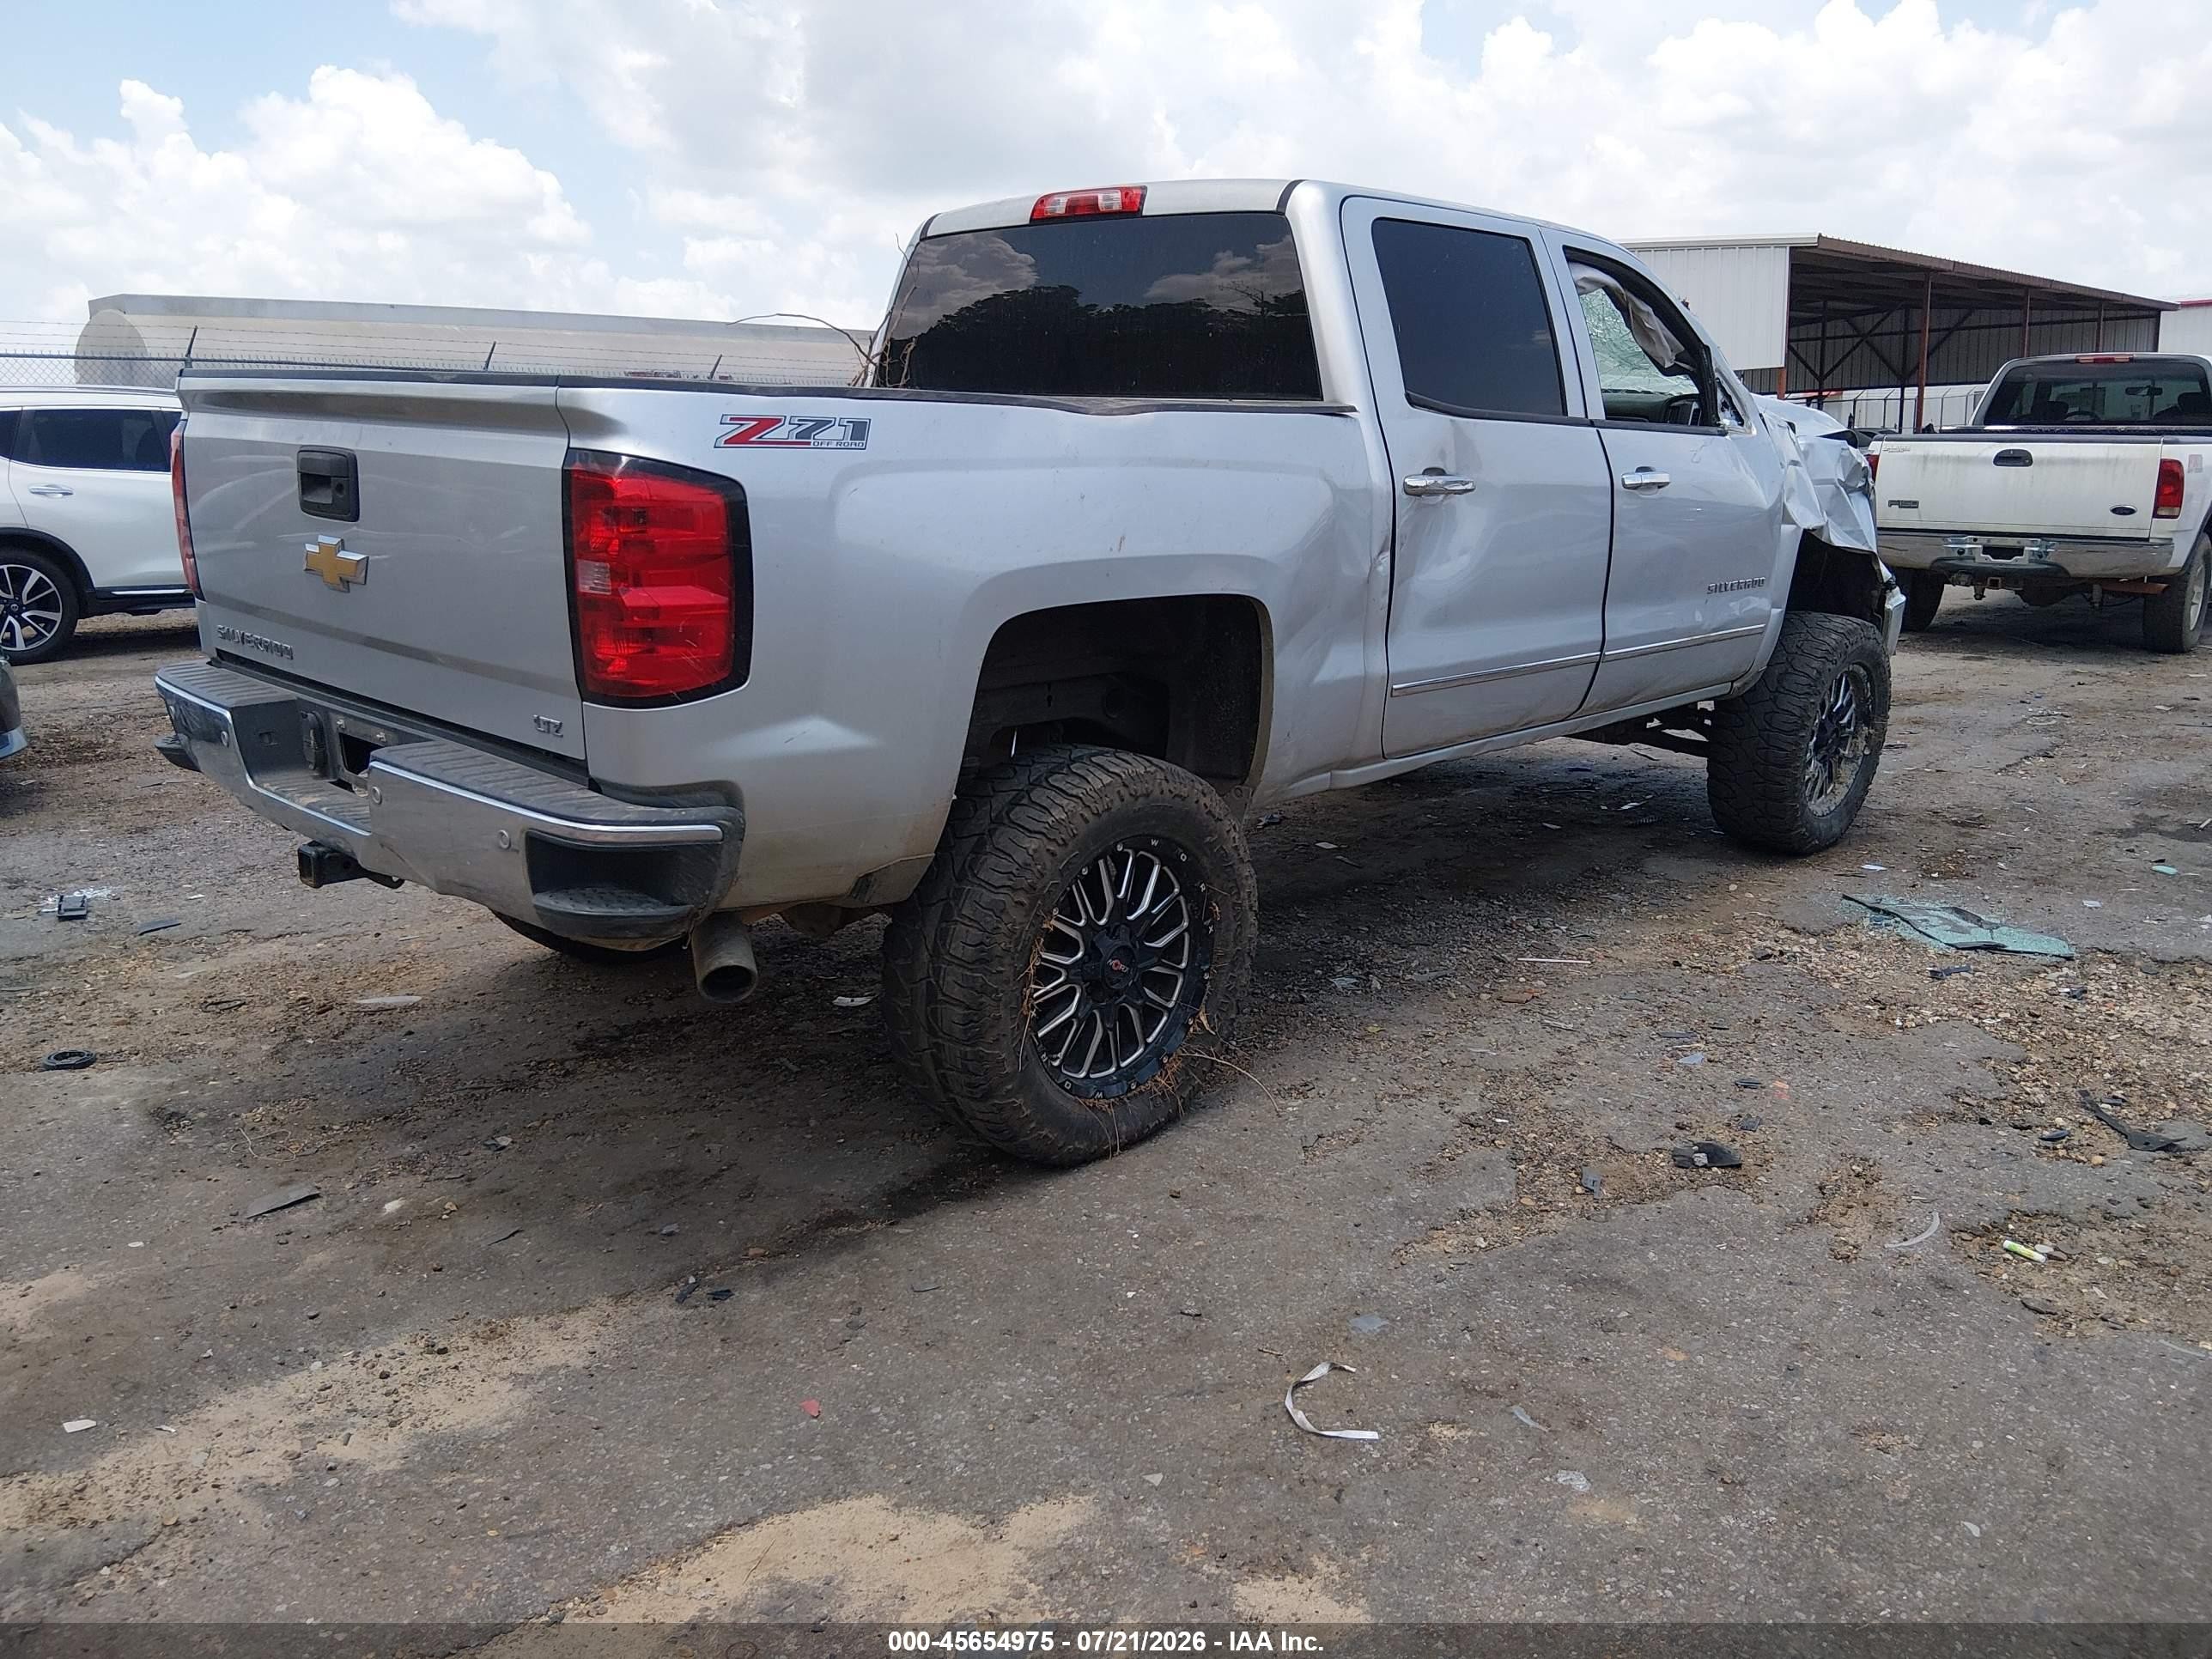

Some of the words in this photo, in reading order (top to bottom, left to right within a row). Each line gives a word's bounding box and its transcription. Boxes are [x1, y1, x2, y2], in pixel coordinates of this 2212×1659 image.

[714, 414, 872, 450] Z71
[1706, 576, 1766, 594] SILVERADO
[217, 624, 294, 659] SILVERADO
[533, 714, 563, 738] LTZ
